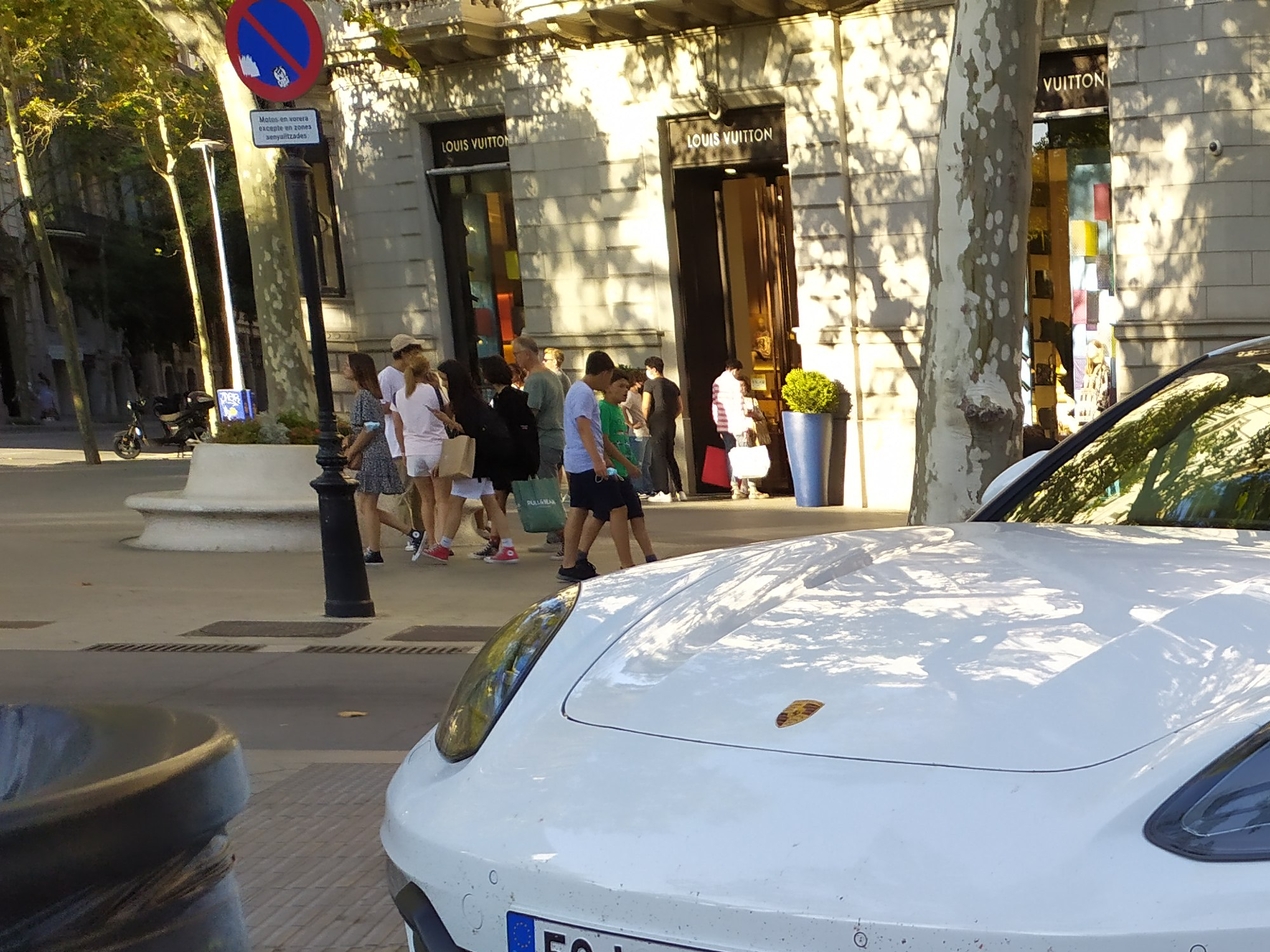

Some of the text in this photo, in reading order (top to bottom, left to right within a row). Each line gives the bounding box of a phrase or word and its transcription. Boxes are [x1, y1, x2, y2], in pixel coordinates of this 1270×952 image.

[1043, 71, 1105, 92] VUITTON
[441, 139, 469, 153] LOUIS
[687, 127, 773, 148] LOUIS VUITTON
